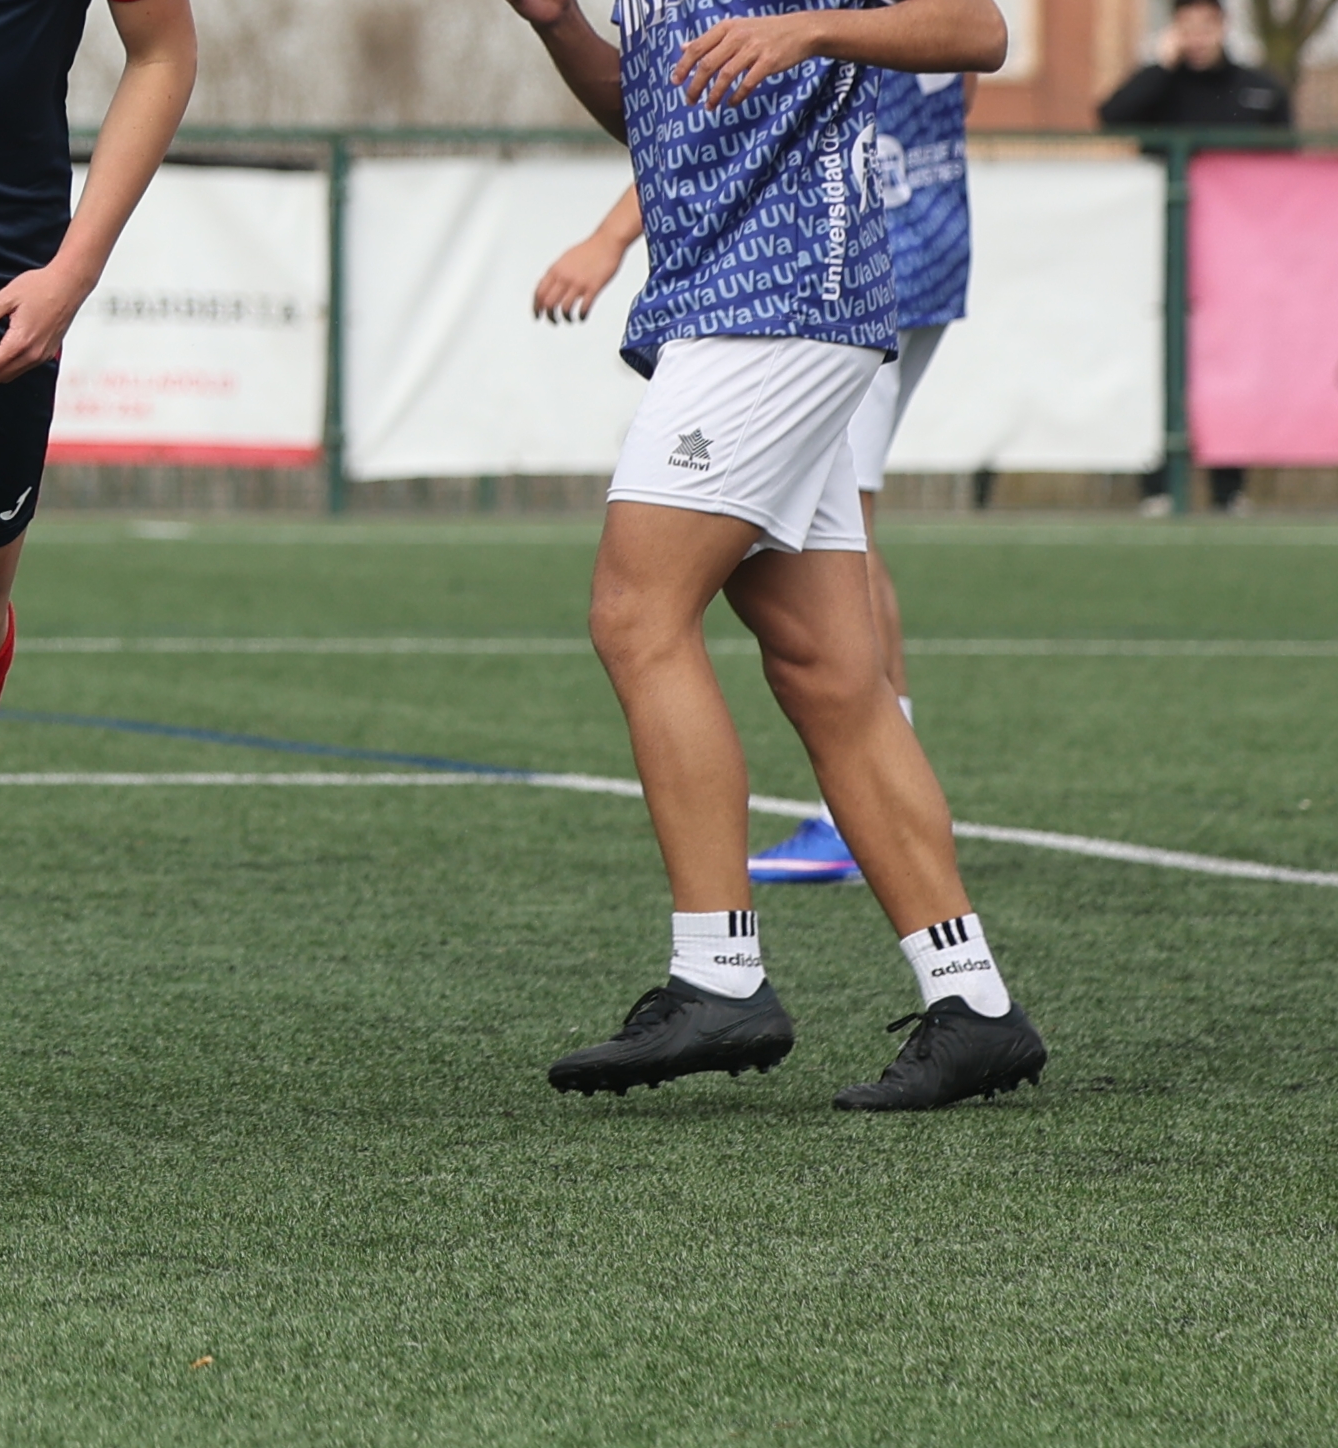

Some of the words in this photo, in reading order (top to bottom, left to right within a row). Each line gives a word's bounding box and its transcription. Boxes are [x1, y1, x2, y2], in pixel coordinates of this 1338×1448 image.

[688, 103, 739, 134] UVa
[741, 92, 794, 120] UVa
[667, 143, 718, 170] UVa
[818, 152, 847, 301] Universidad
[738, 234, 793, 262] UVa
[640, 277, 691, 303] UVa
[667, 287, 717, 319] UVa
[717, 269, 773, 299] UVa
[698, 305, 753, 334] UVa
[824, 295, 865, 322] UVa
[627, 309, 671, 341] UVa
[851, 320, 886, 345] UVa
[667, 455, 711, 472] luanvi
[713, 952, 762, 968] adida
[930, 958, 992, 978] adidas
